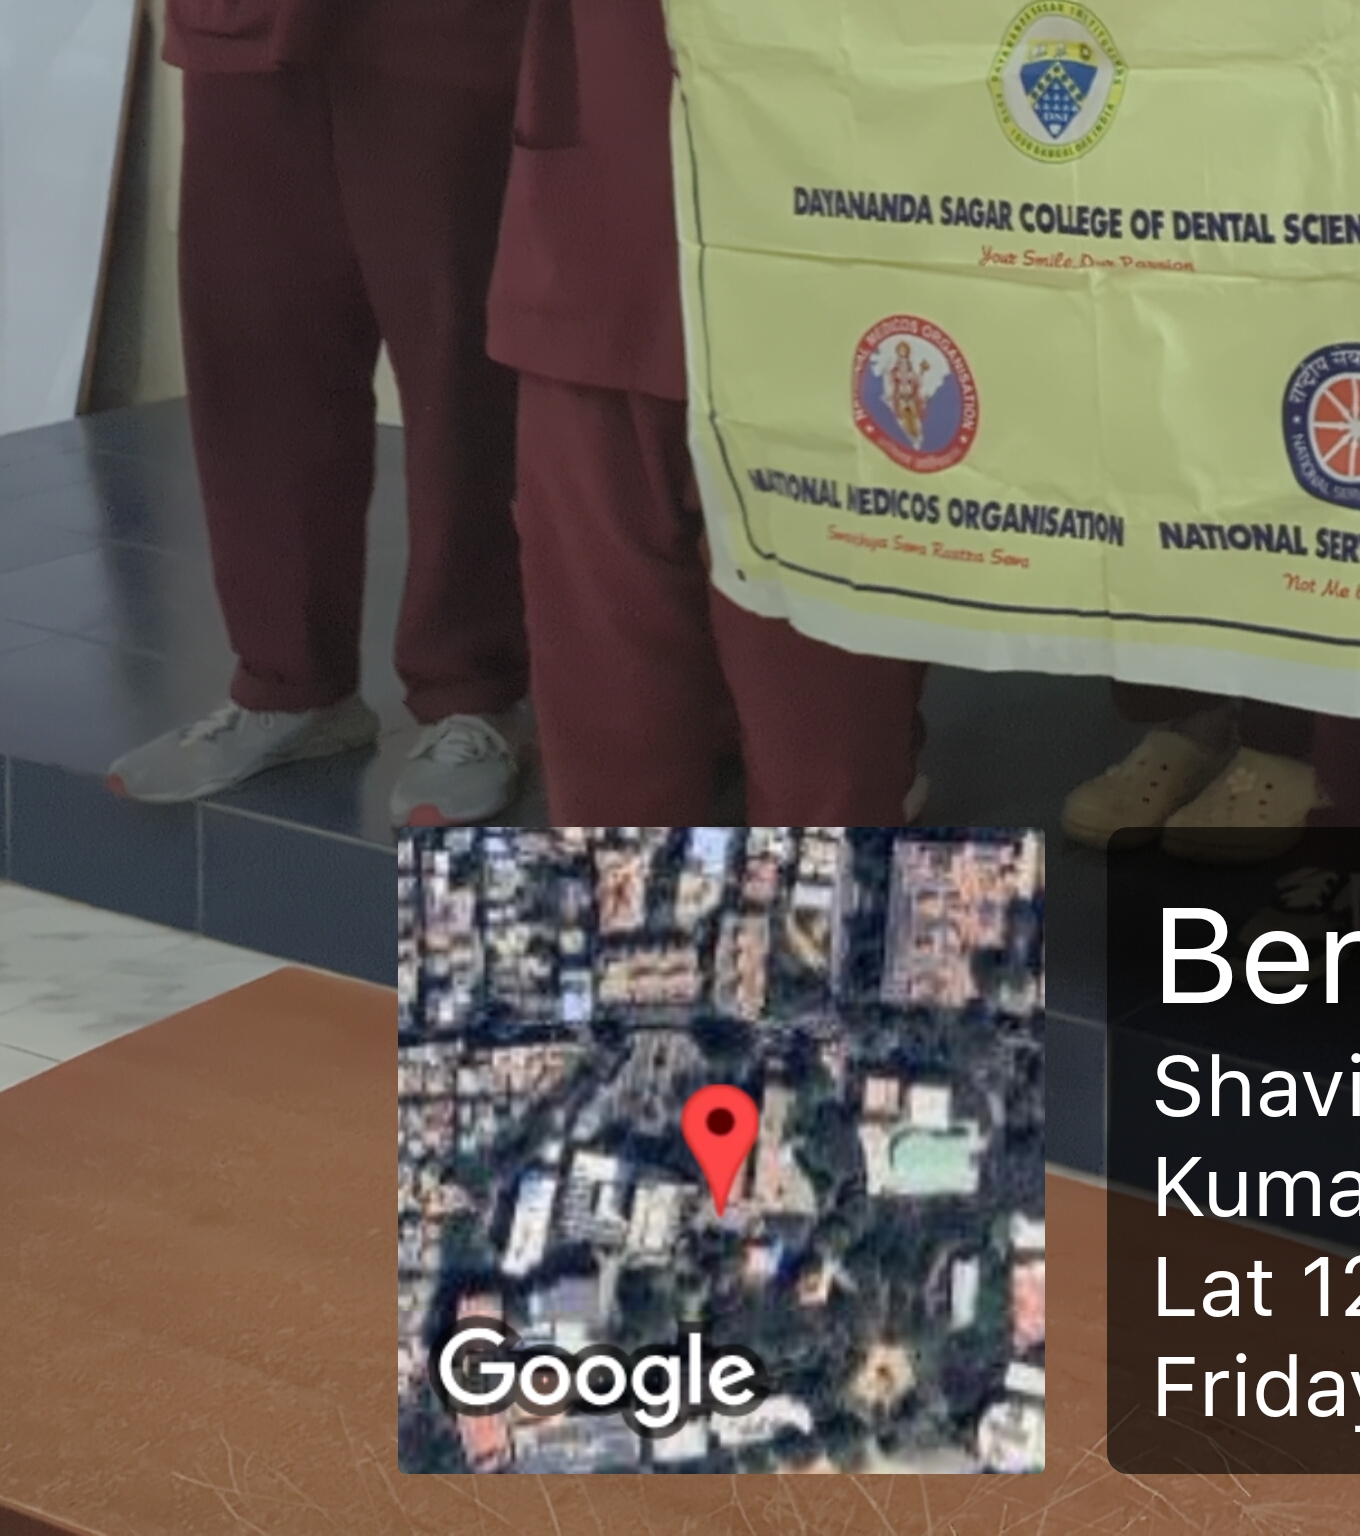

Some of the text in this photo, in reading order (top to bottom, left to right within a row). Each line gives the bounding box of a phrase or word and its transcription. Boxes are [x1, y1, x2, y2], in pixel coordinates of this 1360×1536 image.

[793, 186, 934, 225] DAYANANDA
[940, 195, 1014, 231] SAGAR
[1019, 202, 1123, 239] COLLEGE
[1130, 208, 1164, 241] OF
[1171, 210, 1276, 244] DENTAL
[978, 245, 1017, 266] Your
[921, 325, 976, 431] ORGANISATION
[1292, 433, 1329, 495] NATIONAL
[748, 468, 842, 509] NATIONAL
[947, 498, 1125, 547] ORGANISATION
[1158, 522, 1308, 556] NATIONAL
[1282, 573, 1316, 594] Not
[1321, 579, 1350, 598] Me
